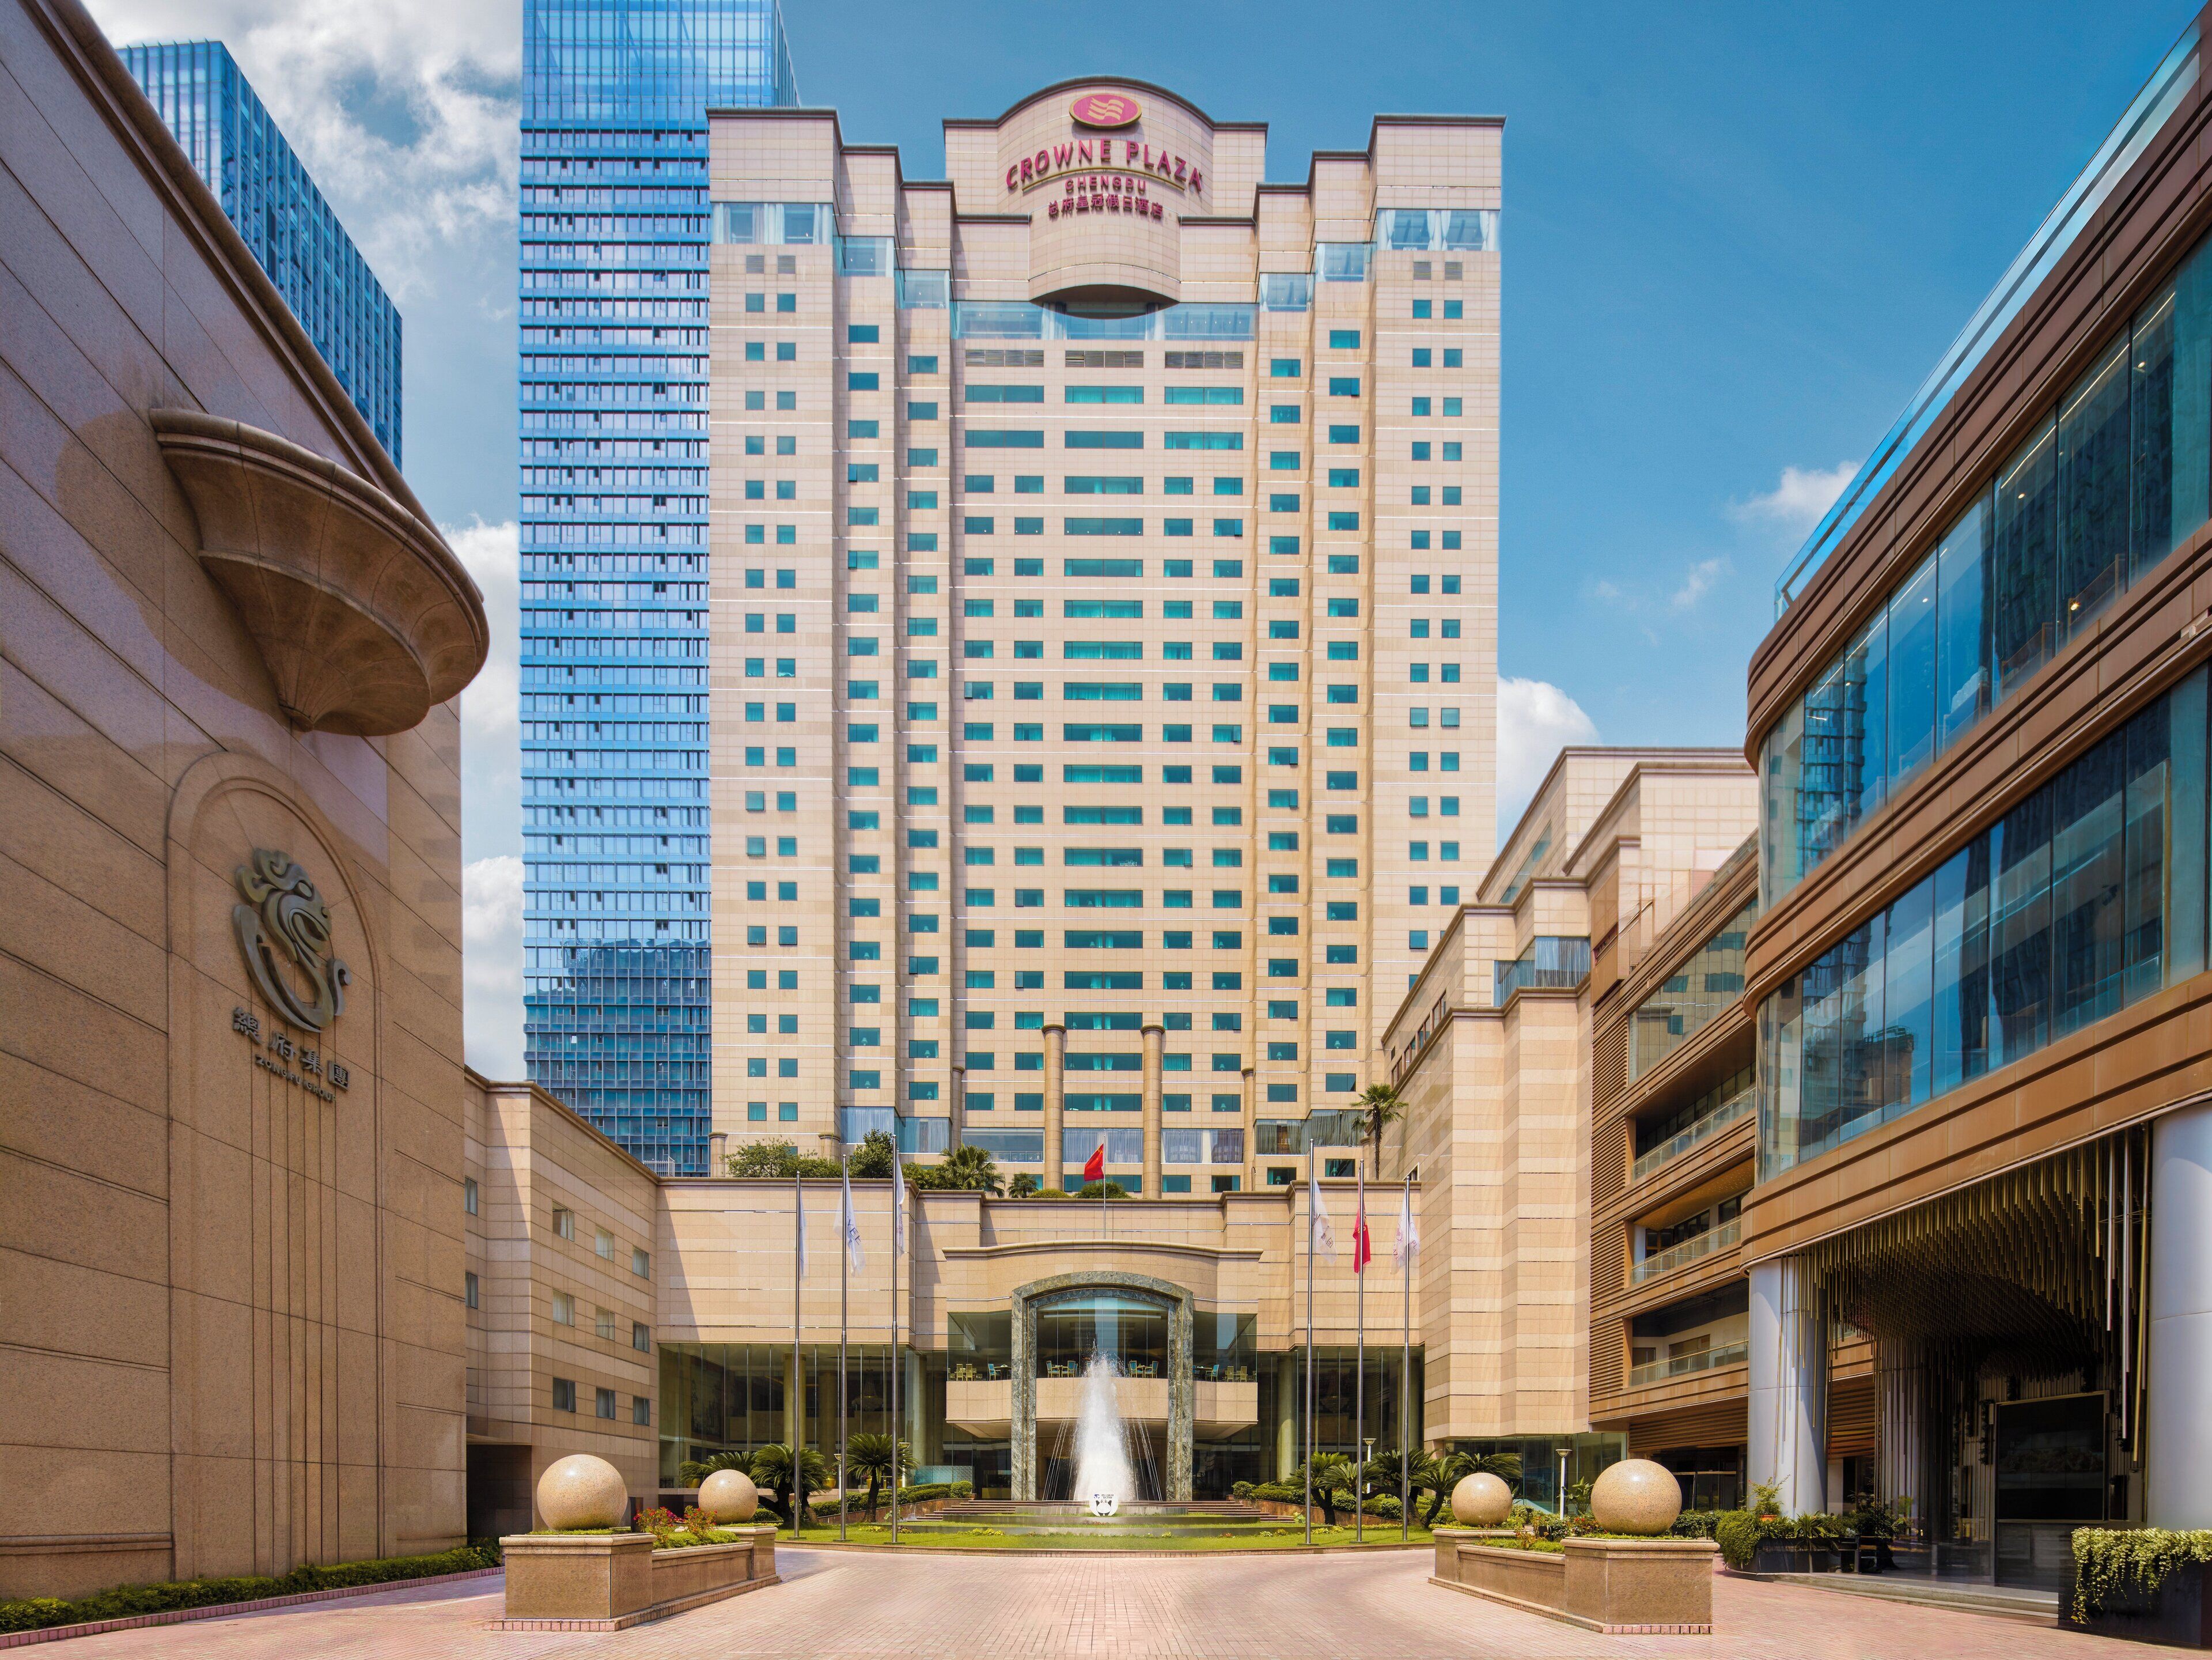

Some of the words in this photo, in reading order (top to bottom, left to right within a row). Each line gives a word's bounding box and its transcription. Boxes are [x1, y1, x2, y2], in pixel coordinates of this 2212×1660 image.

[1006, 138, 1111, 189] CROWNE
[1126, 140, 1202, 191] PLAZA
[1065, 175, 1146, 192] CHENGDU
[1048, 193, 1164, 219] 总府皇冠假日酒店
[255, 1054, 287, 1077] ZONG
[287, 1073, 302, 1086] FU
[302, 1080, 336, 1103] GROUP
